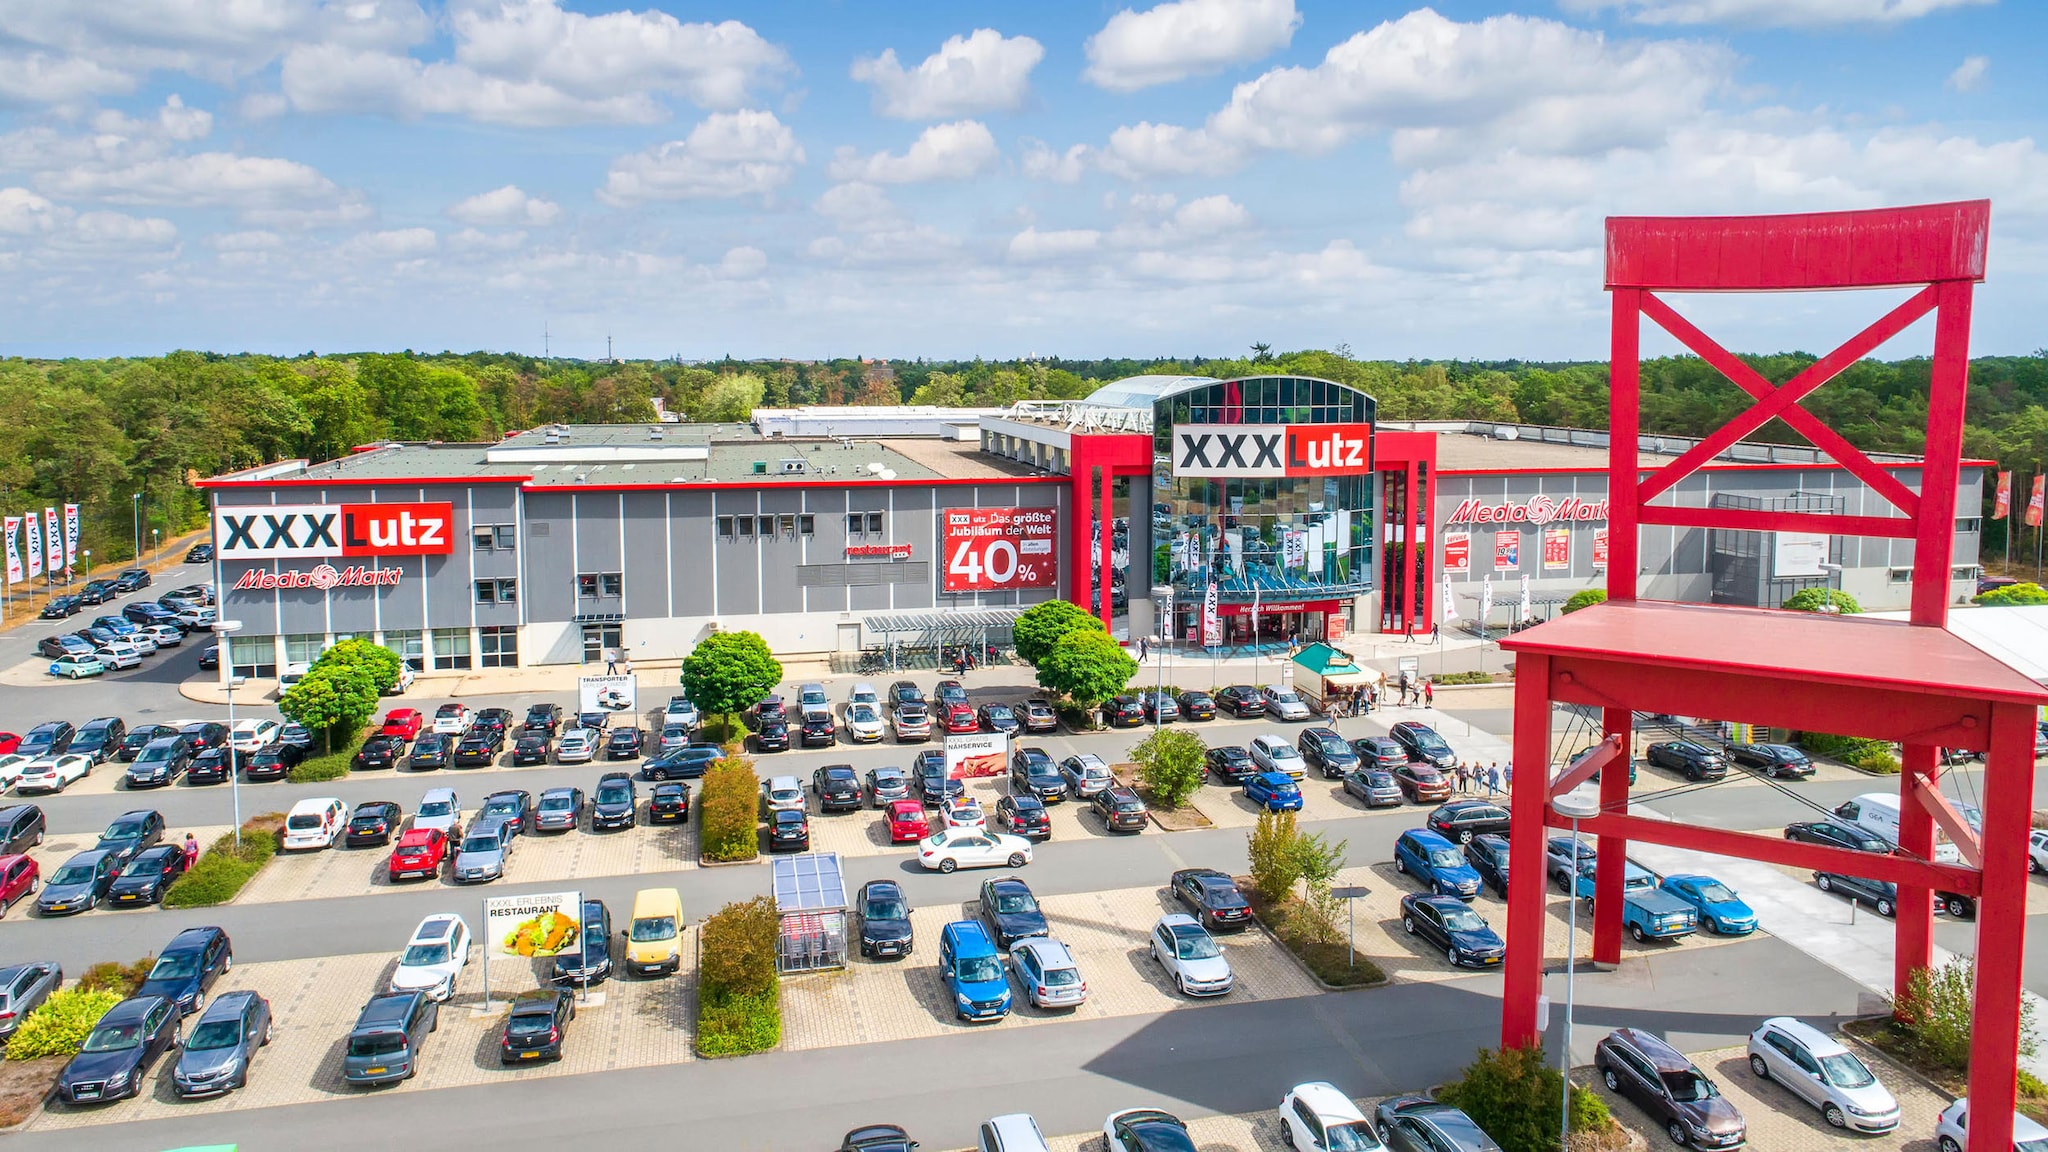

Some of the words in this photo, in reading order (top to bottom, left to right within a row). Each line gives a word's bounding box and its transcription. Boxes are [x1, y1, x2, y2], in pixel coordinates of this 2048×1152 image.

[1180, 433, 1363, 468] XXXLutz
[990, 512, 1010, 523] Das
[1013, 513, 1051, 525] größte
[1447, 499, 1527, 524] Media
[1551, 497, 1609, 521] Mark
[222, 511, 444, 550] XXXLutz
[950, 526, 1002, 536] Jubiläum
[1006, 525, 1024, 535] der
[1026, 525, 1051, 534] Welt
[233, 568, 310, 590] Media
[333, 565, 403, 587] Markt
[490, 899, 514, 907] XXXL
[517, 895, 563, 906] ERLEBNIS
[490, 904, 560, 917] RESTAURANT
